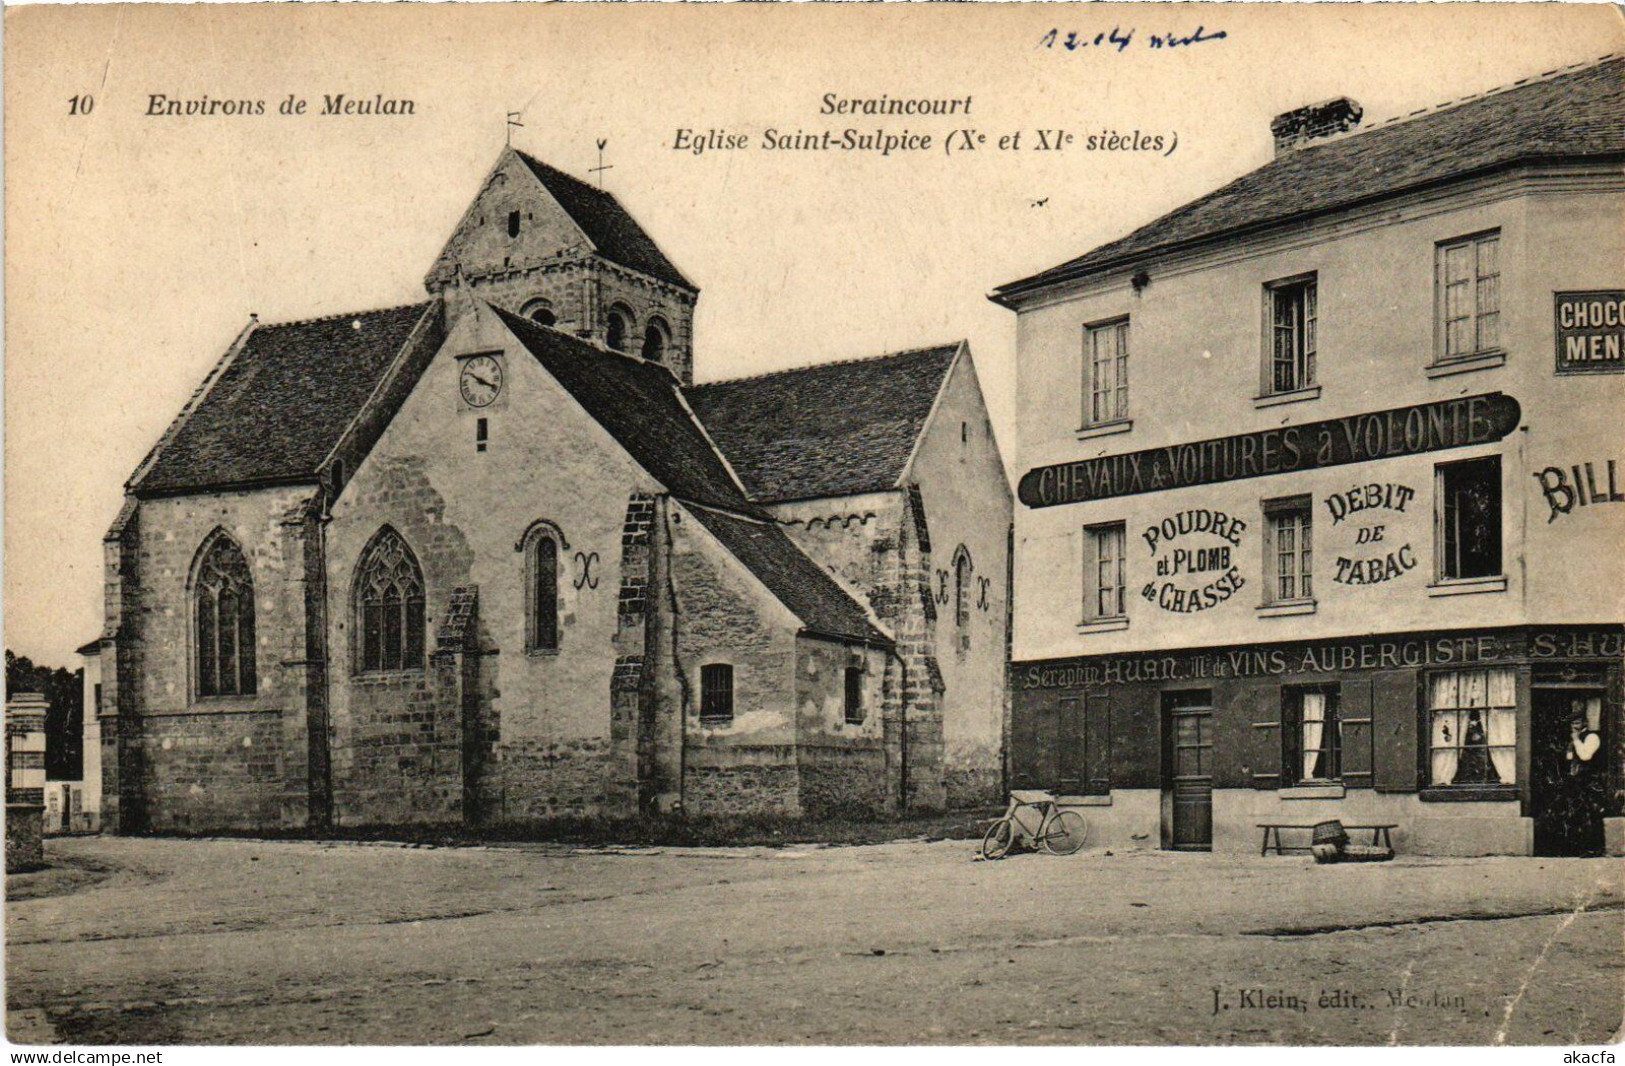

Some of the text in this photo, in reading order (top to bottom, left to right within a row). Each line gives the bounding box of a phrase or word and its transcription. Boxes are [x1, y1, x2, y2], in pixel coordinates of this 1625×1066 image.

[1038, 453, 1145, 505] CHEVAUX
[1150, 461, 1166, 489] &
[1164, 428, 1301, 485] VOITURES
[1532, 460, 1625, 525] BILL
[1142, 509, 1247, 557] POUDRE
[1355, 525, 1385, 545] DE
[1157, 546, 1231, 576] et PLOMB
[1333, 542, 1418, 585] TABAC
[1141, 565, 1246, 613] de CHASSE
[1212, 655, 1228, 677] de
[1296, 636, 1499, 674] AUBERGISTE
